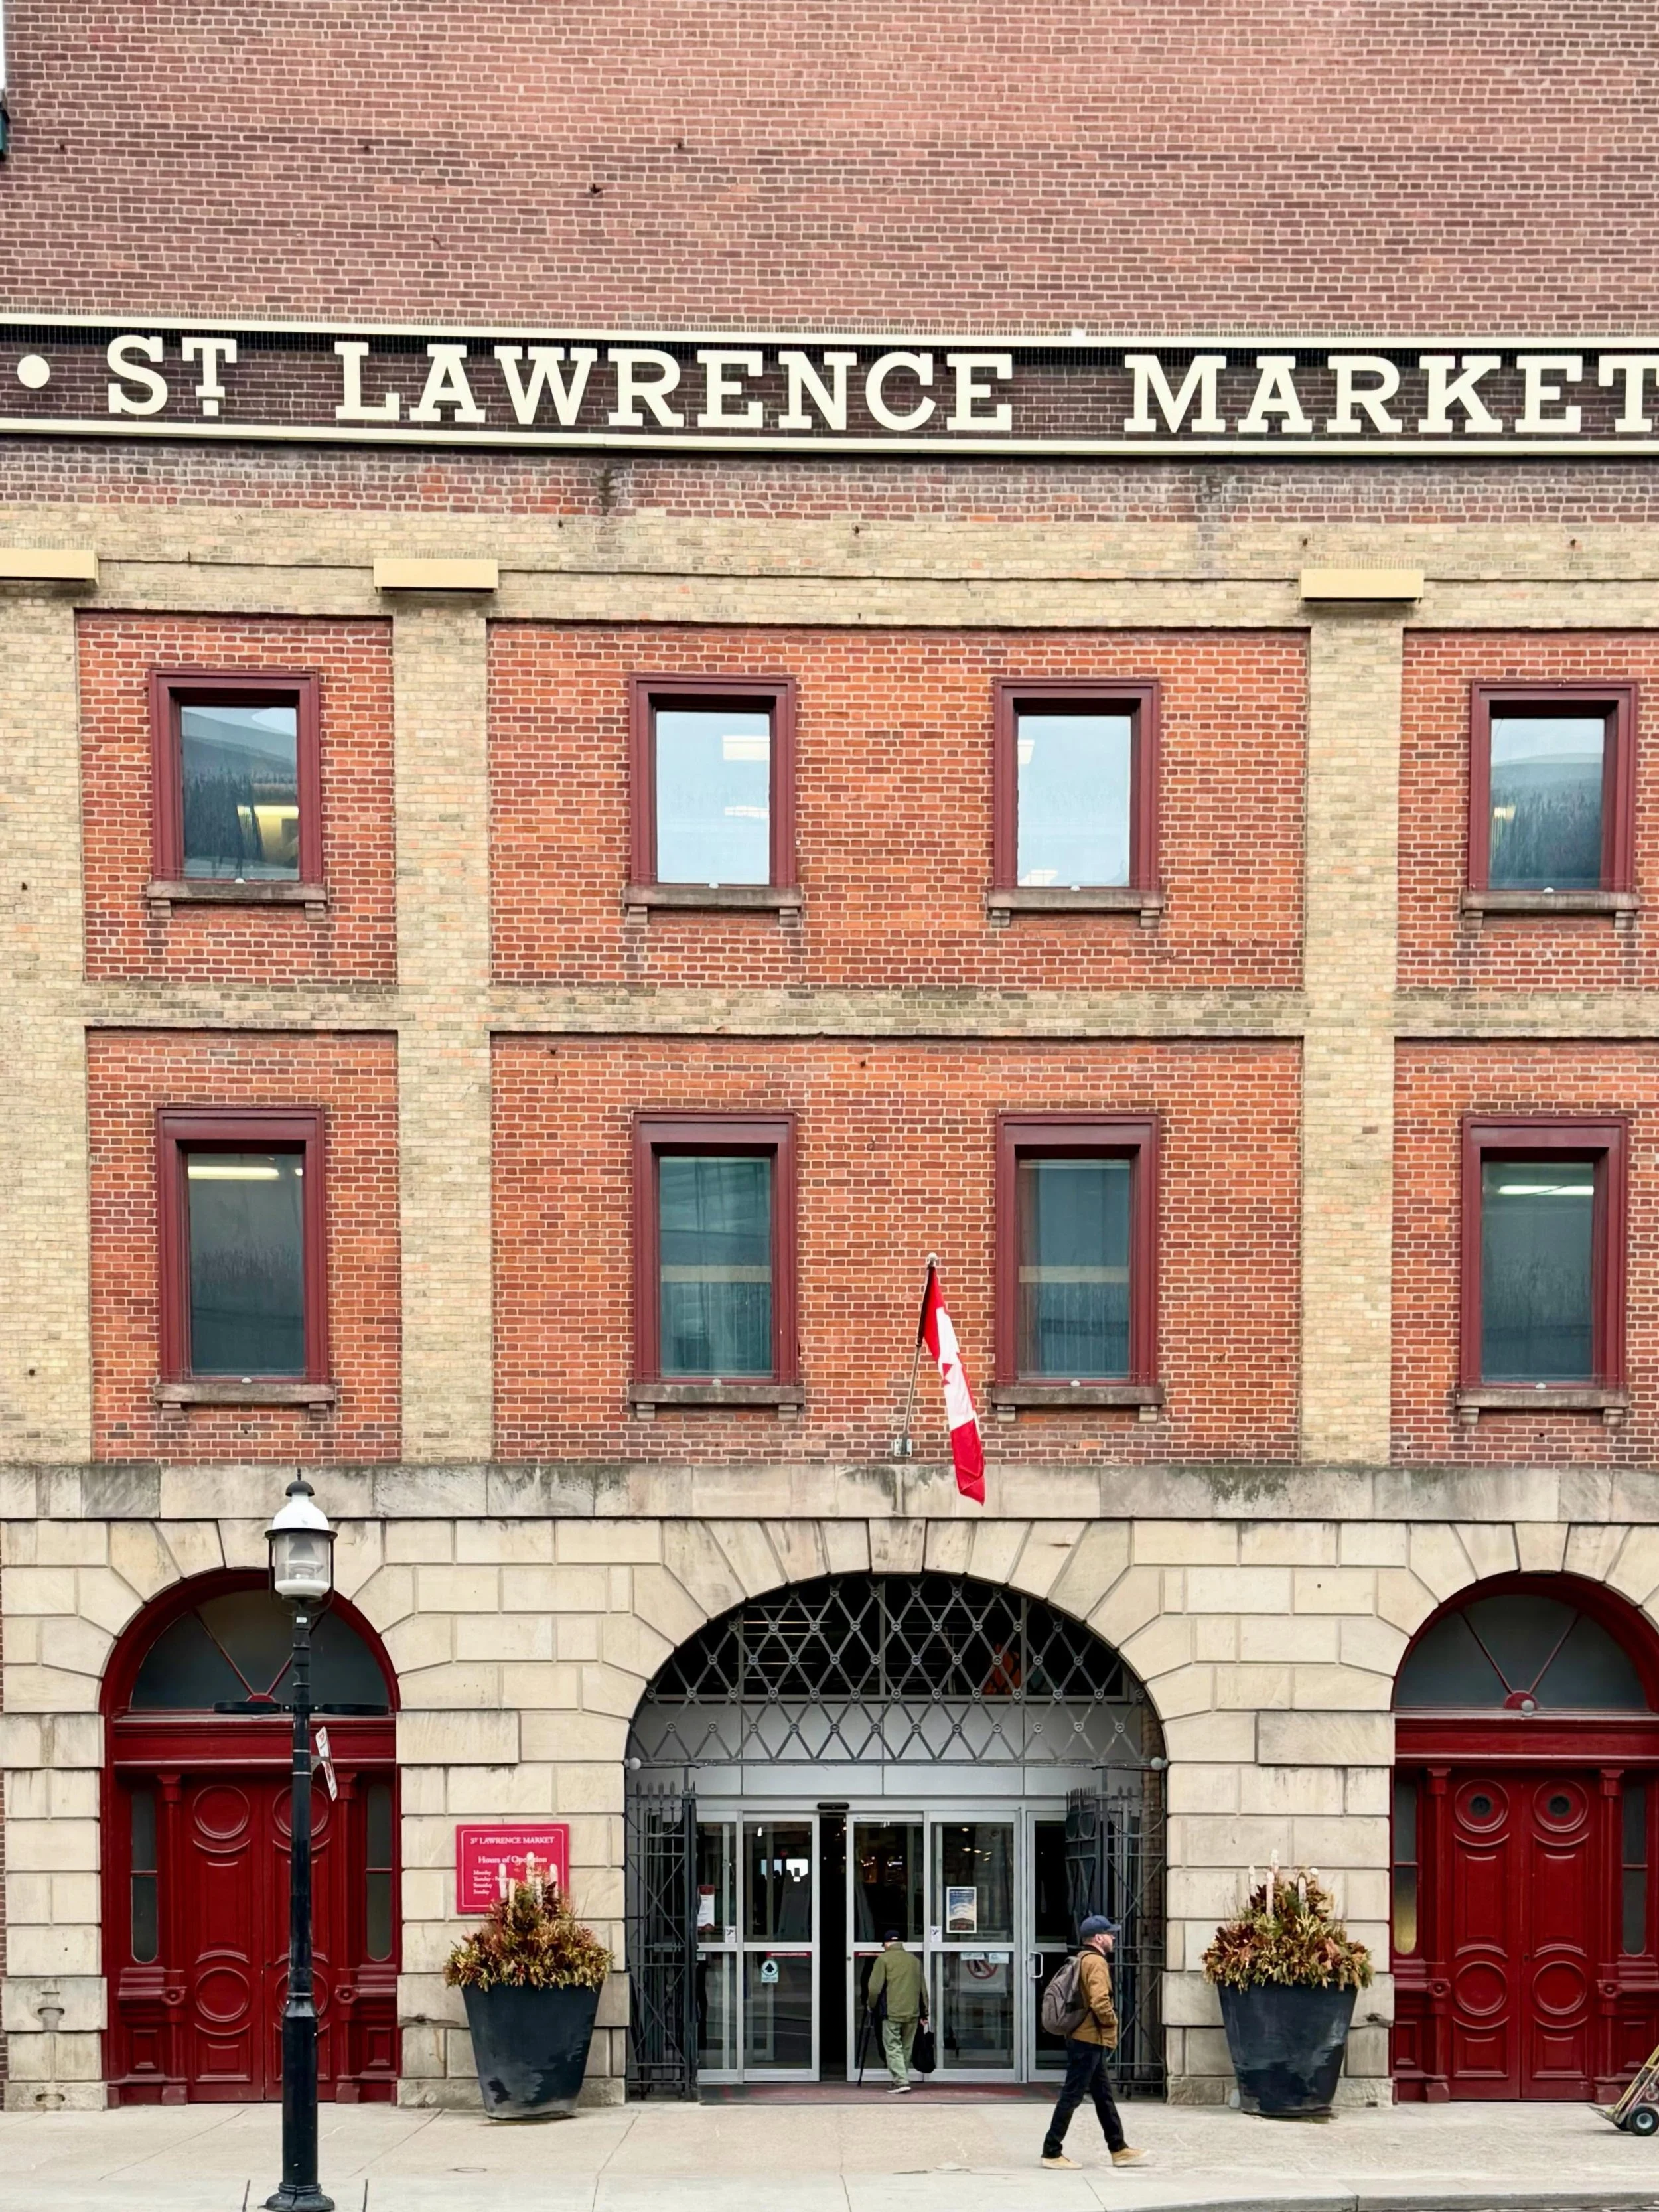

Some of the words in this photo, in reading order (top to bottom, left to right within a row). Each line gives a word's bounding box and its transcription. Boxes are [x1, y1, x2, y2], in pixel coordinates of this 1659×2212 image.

[107, 335, 237, 419] ST
[334, 341, 1013, 431] LAWRENCE
[1124, 354, 1659, 433] MARKET
[478, 1855, 500, 1864] Hours
